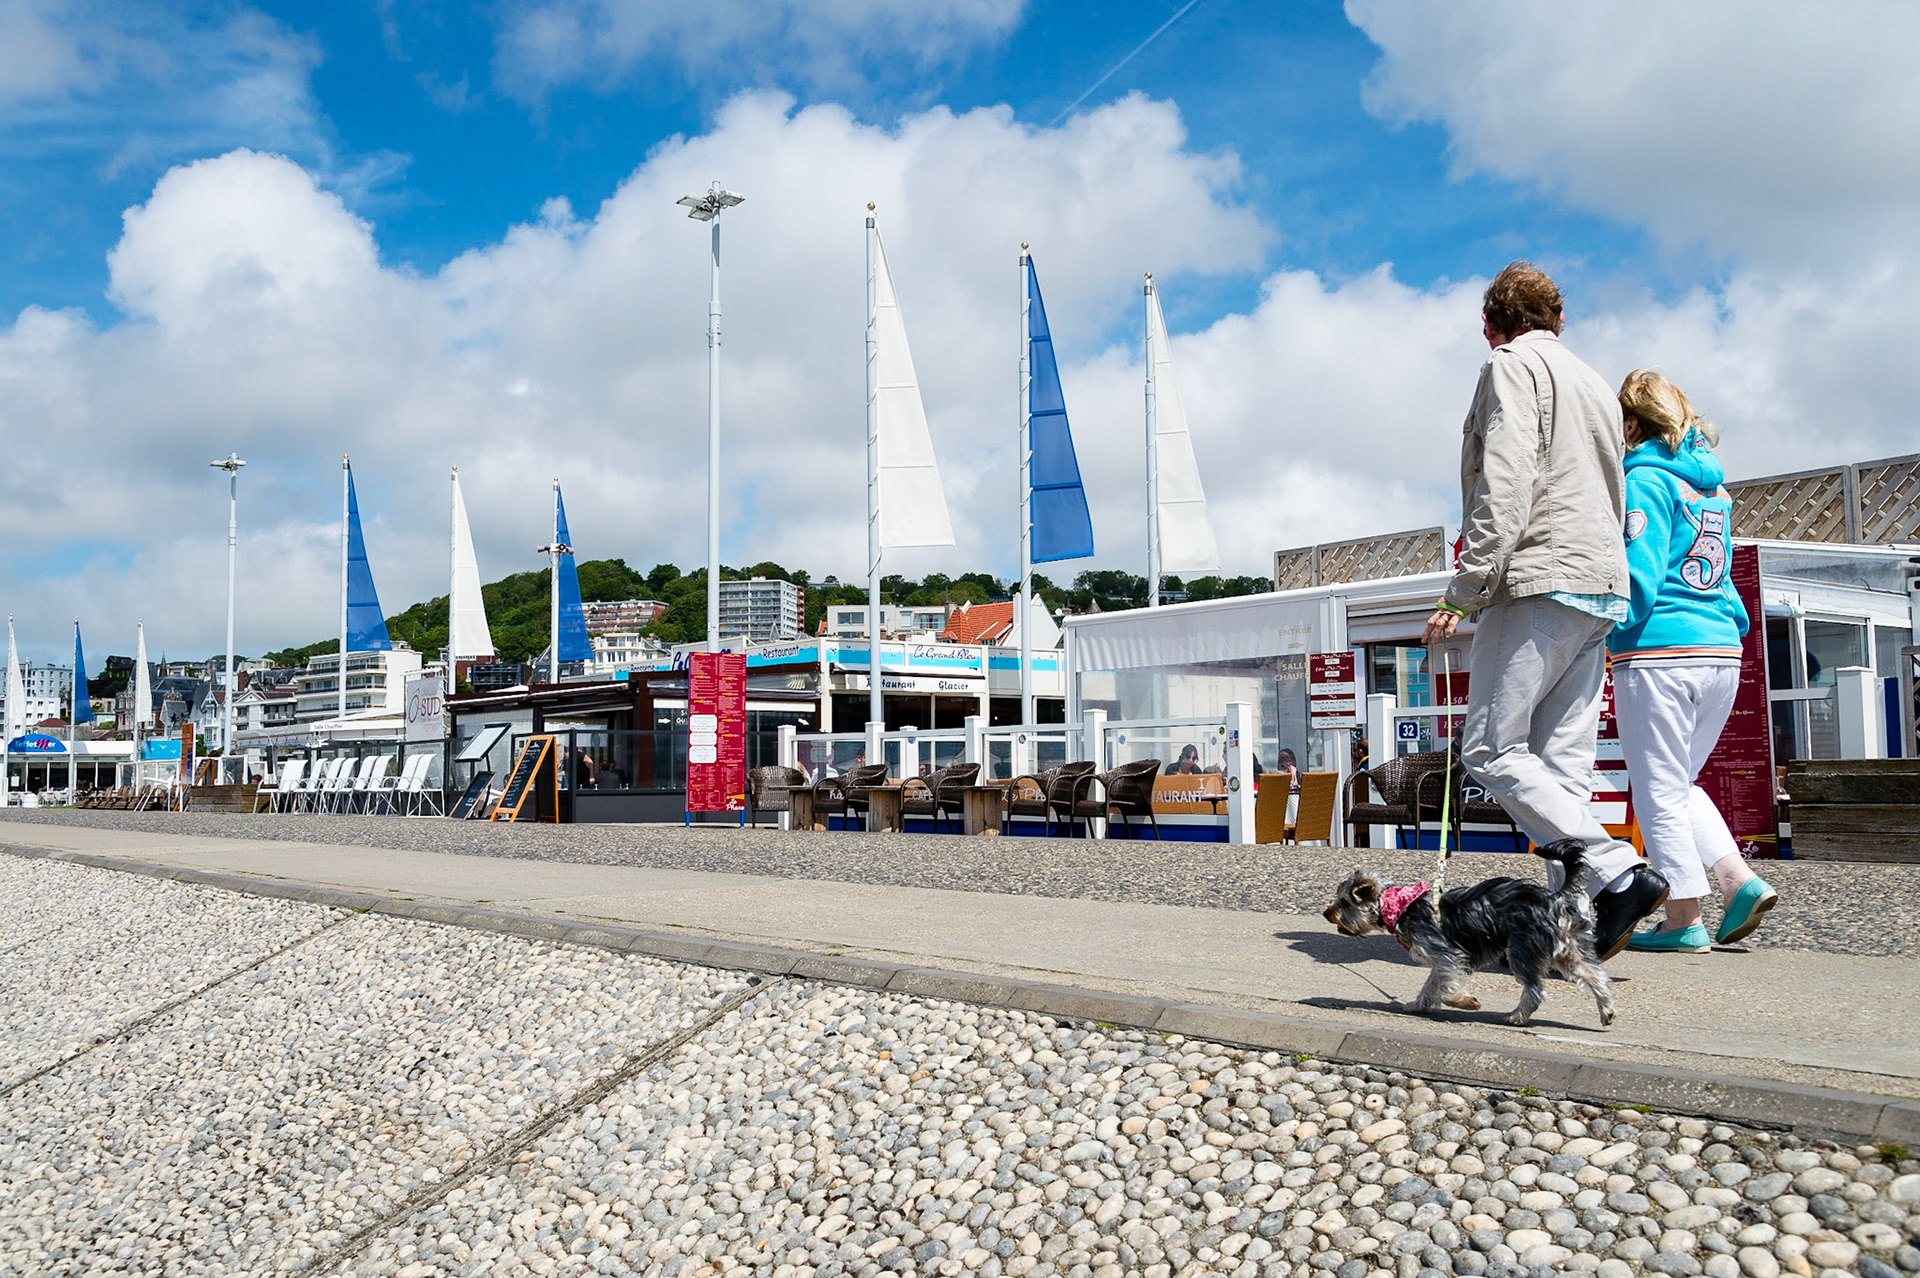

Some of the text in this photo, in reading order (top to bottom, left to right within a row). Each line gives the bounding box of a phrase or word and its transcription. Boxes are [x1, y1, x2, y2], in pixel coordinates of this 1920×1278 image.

[762, 646, 800, 660] Restaurant
[926, 647, 955, 660] Grand
[956, 648, 976, 660] Bleu
[938, 681, 969, 690] Glacier
[1402, 724, 1415, 737] 32
[1742, 840, 1759, 854] Le
